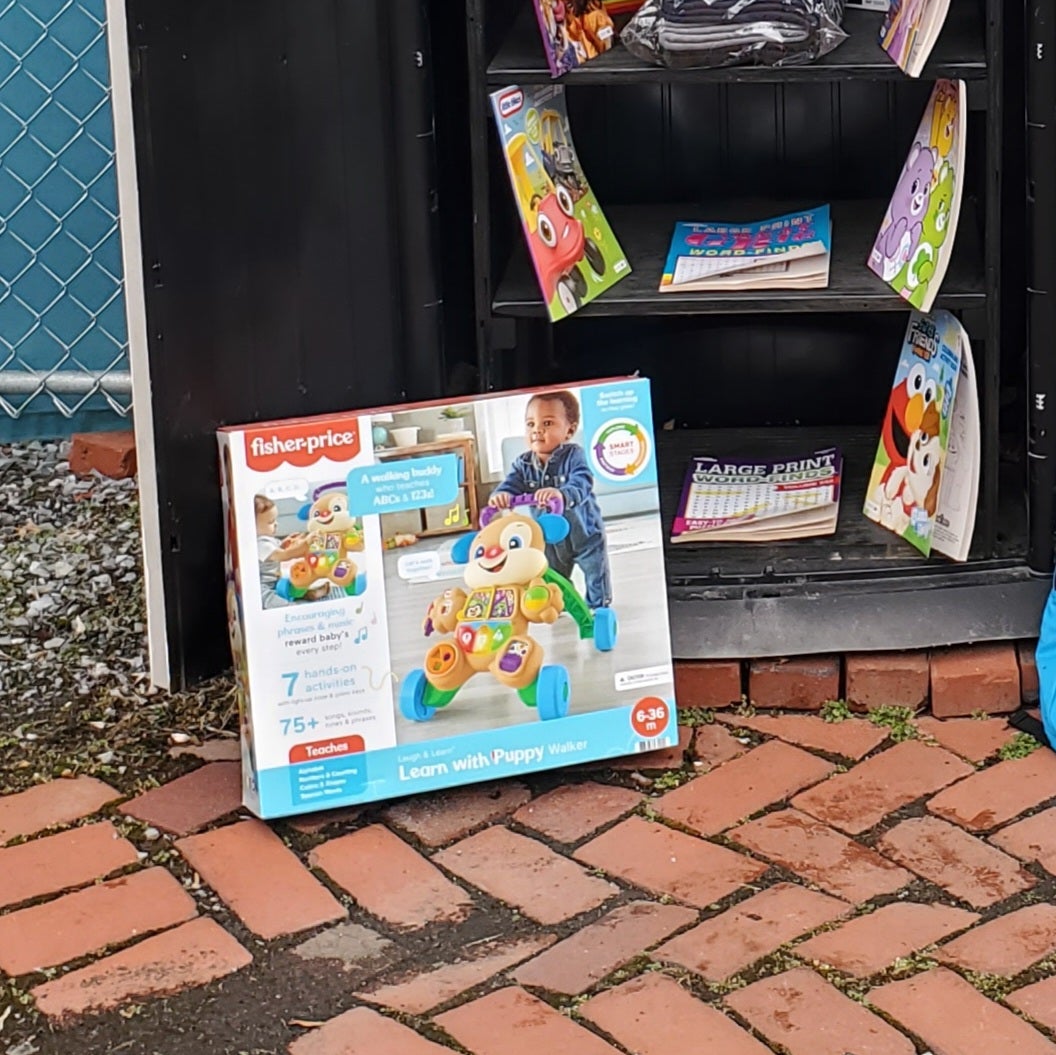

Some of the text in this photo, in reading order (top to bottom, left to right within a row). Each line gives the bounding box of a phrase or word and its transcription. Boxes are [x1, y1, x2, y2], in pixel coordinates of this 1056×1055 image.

[689, 245, 804, 257] WORD-FIND
[251, 430, 354, 456] fisher-price
[609, 442, 634, 450] SMART
[695, 454, 835, 476] LARGE PRINT
[361, 474, 370, 484] A
[411, 464, 443, 479] buddy
[694, 467, 834, 485] WORD-FINDS
[686, 518, 726, 527] EASY-TO
[284, 608, 346, 625] Encouraging
[277, 624, 315, 638] phrases
[284, 630, 349, 648] reward baby's
[296, 642, 342, 657] every step!
[281, 663, 357, 697] 7 hands-on
[305, 676, 356, 693] activities
[636, 707, 665, 722] 6-36
[280, 715, 319, 736] 75+
[645, 722, 656, 730] m
[305, 742, 349, 758] Teaches
[399, 740, 588, 782] Learn with Puppy Walker
